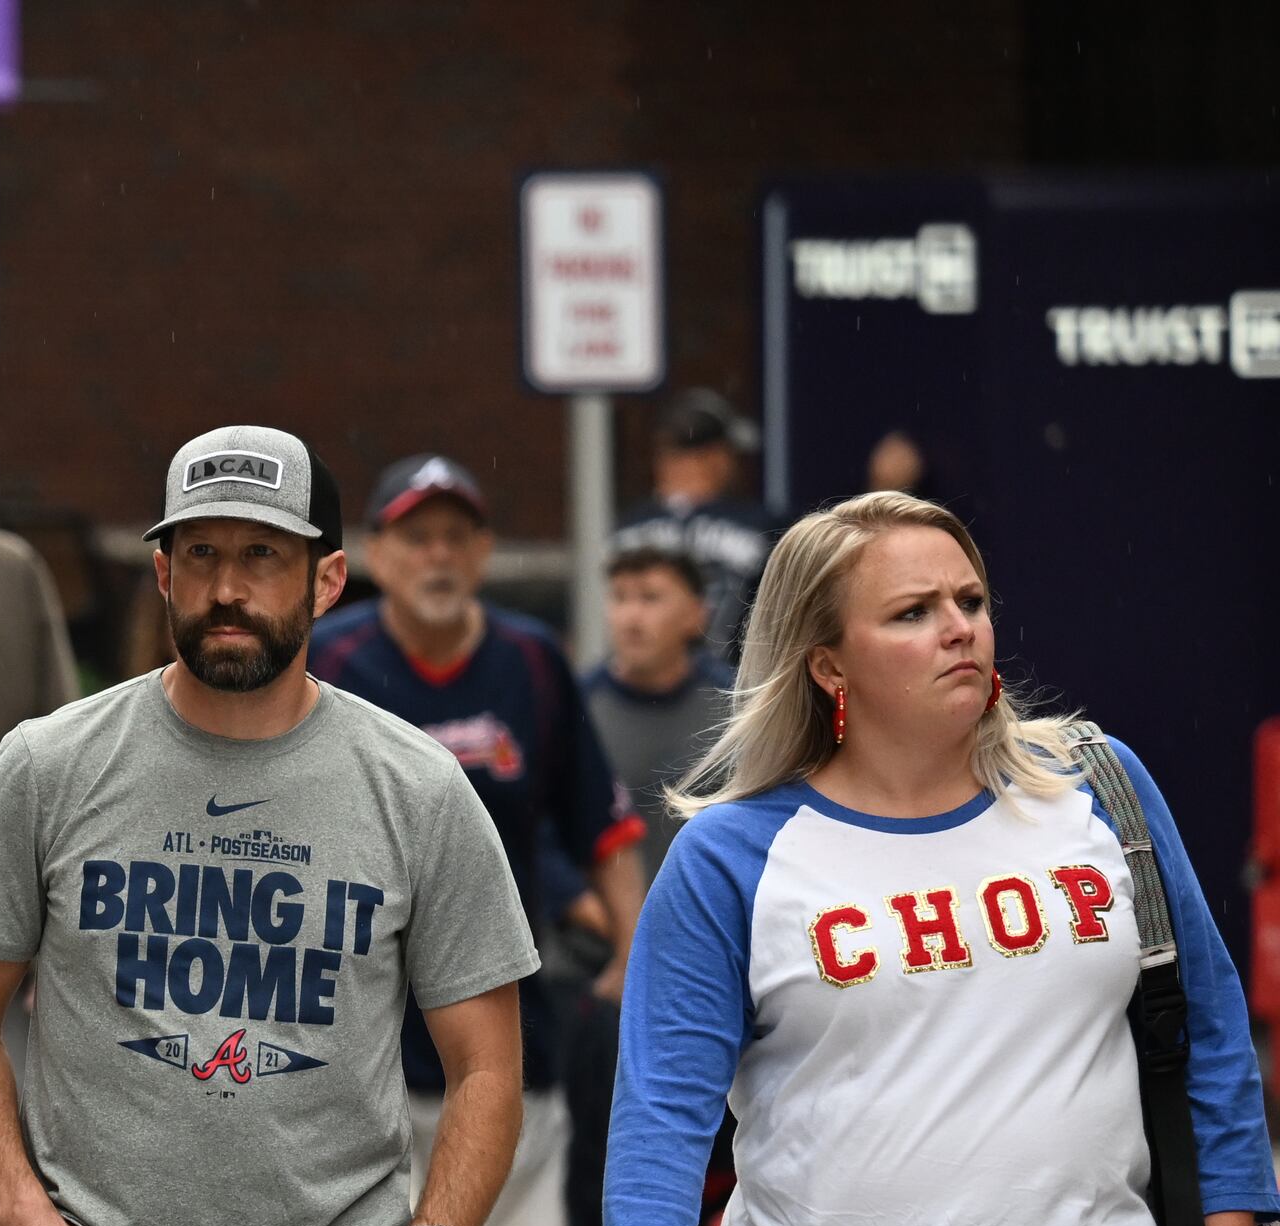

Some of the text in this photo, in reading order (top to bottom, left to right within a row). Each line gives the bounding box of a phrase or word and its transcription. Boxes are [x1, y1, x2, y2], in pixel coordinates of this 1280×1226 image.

[1047, 305, 1225, 365] TRUIST
[163, 832, 312, 864] ATL POSTSEASON
[79, 860, 384, 955] BRING IT
[809, 864, 1114, 989] CHOP
[116, 932, 341, 1025] HOME
[165, 1042, 180, 1058] 20
[265, 1053, 280, 1068] 21
